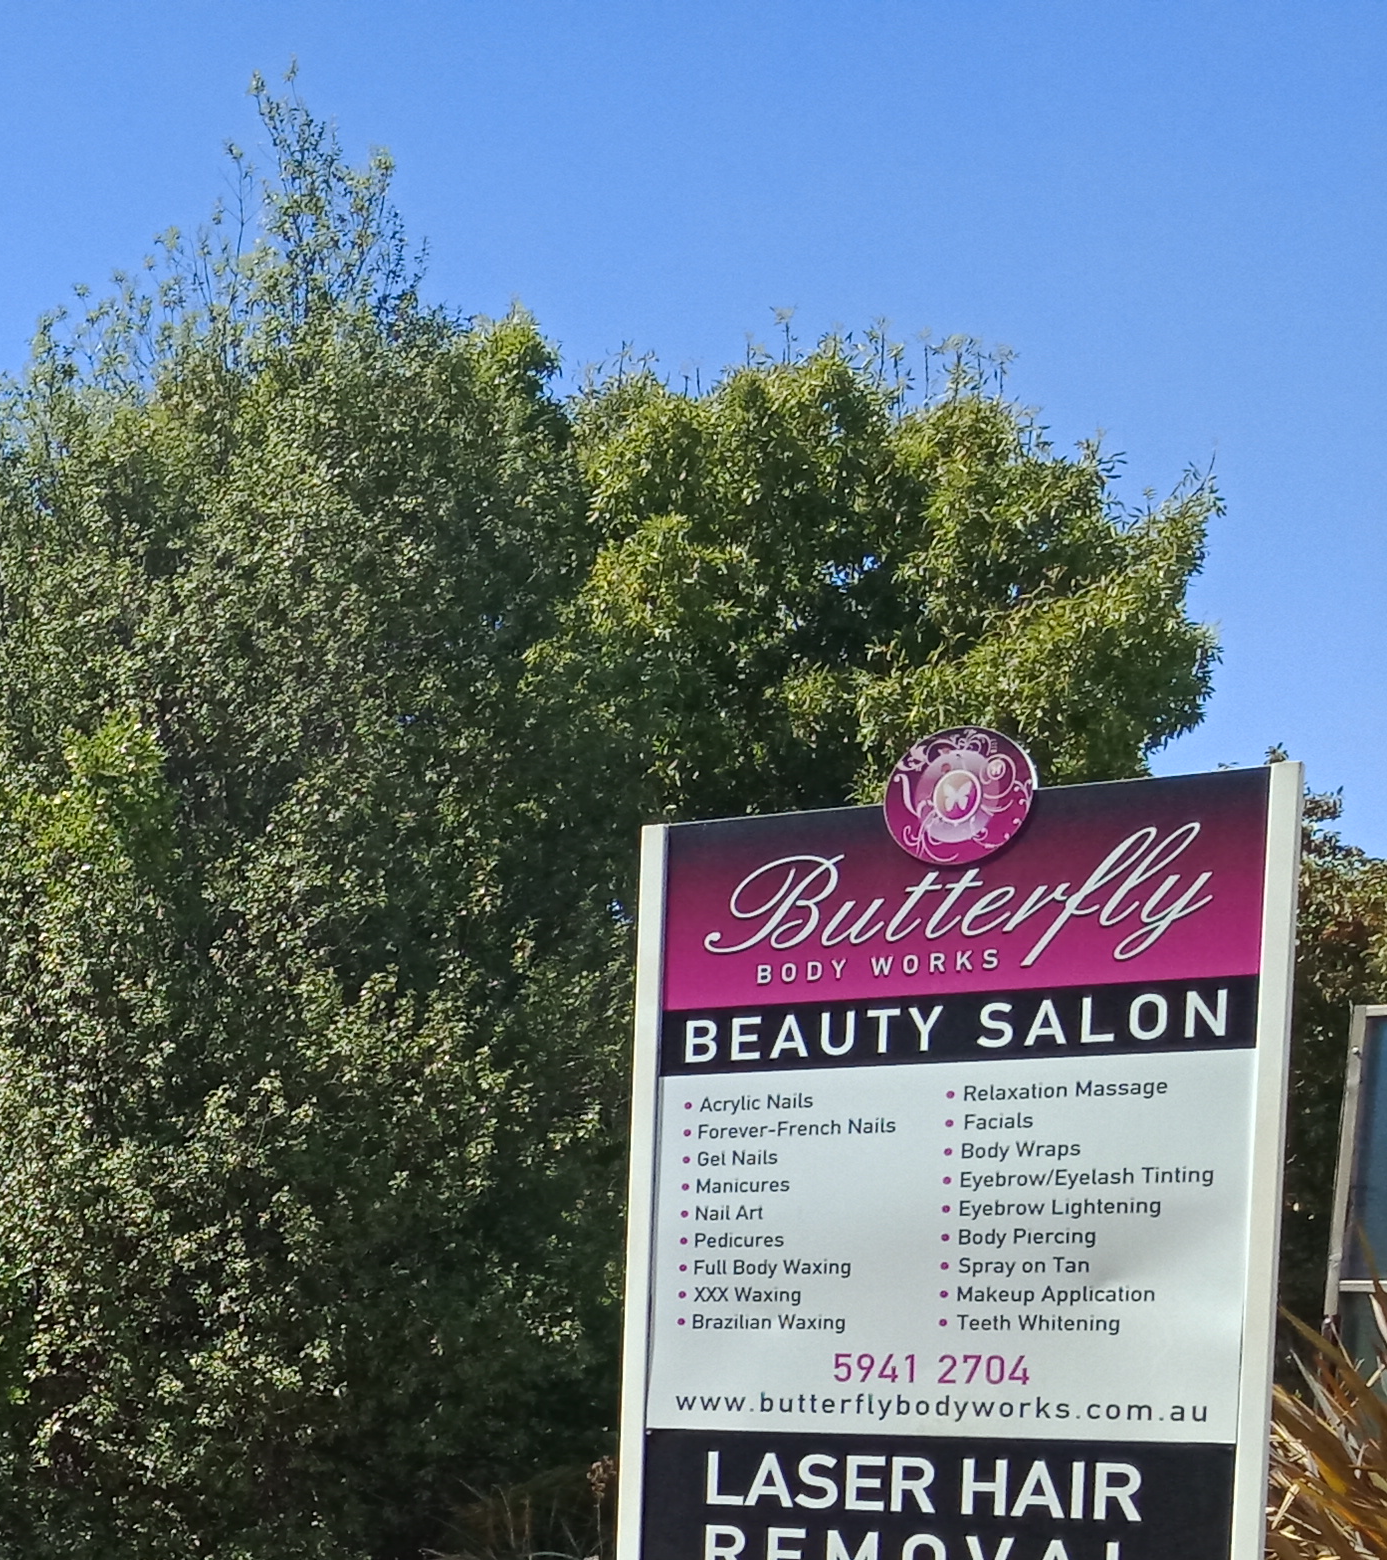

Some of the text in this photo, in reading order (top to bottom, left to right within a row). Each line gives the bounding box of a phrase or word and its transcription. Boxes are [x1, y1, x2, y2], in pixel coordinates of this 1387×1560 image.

[703, 820, 1214, 968] Butterfly
[756, 948, 1000, 985] BODY WORKS
[684, 988, 1229, 1064] BEAUTY SALON
[963, 1080, 1168, 1102] Relaxation Massage
[699, 1093, 814, 1115] Acrylic Nails
[697, 1118, 896, 1139] Forever-French Nails
[964, 1112, 1034, 1130] Facials
[697, 1150, 778, 1167] Gel Nails
[961, 1140, 1081, 1162] Body Wraps
[696, 1178, 790, 1194] Manicures
[960, 1165, 1215, 1191] Eyebrow/Eyelash Tinting
[695, 1205, 764, 1221] Nail Art
[959, 1197, 1161, 1220] Eyebrow Lightening
[694, 1233, 785, 1248] Pedicures
[958, 1228, 1097, 1249] Body Piercing
[693, 1259, 852, 1278] Full Body Waxing
[958, 1257, 1090, 1277] Spray on Tan
[693, 1286, 802, 1306] XXX Waxing
[956, 1285, 1155, 1306] Makeup Application
[692, 1314, 846, 1334] Brazilian Waxing
[957, 1313, 1121, 1335] Teeth Whitening
[834, 1353, 1030, 1385] 5941 2704
[675, 1392, 1209, 1424] www.butterflybodyworks.com.au
[705, 1451, 1143, 1522] LASER HAIR
